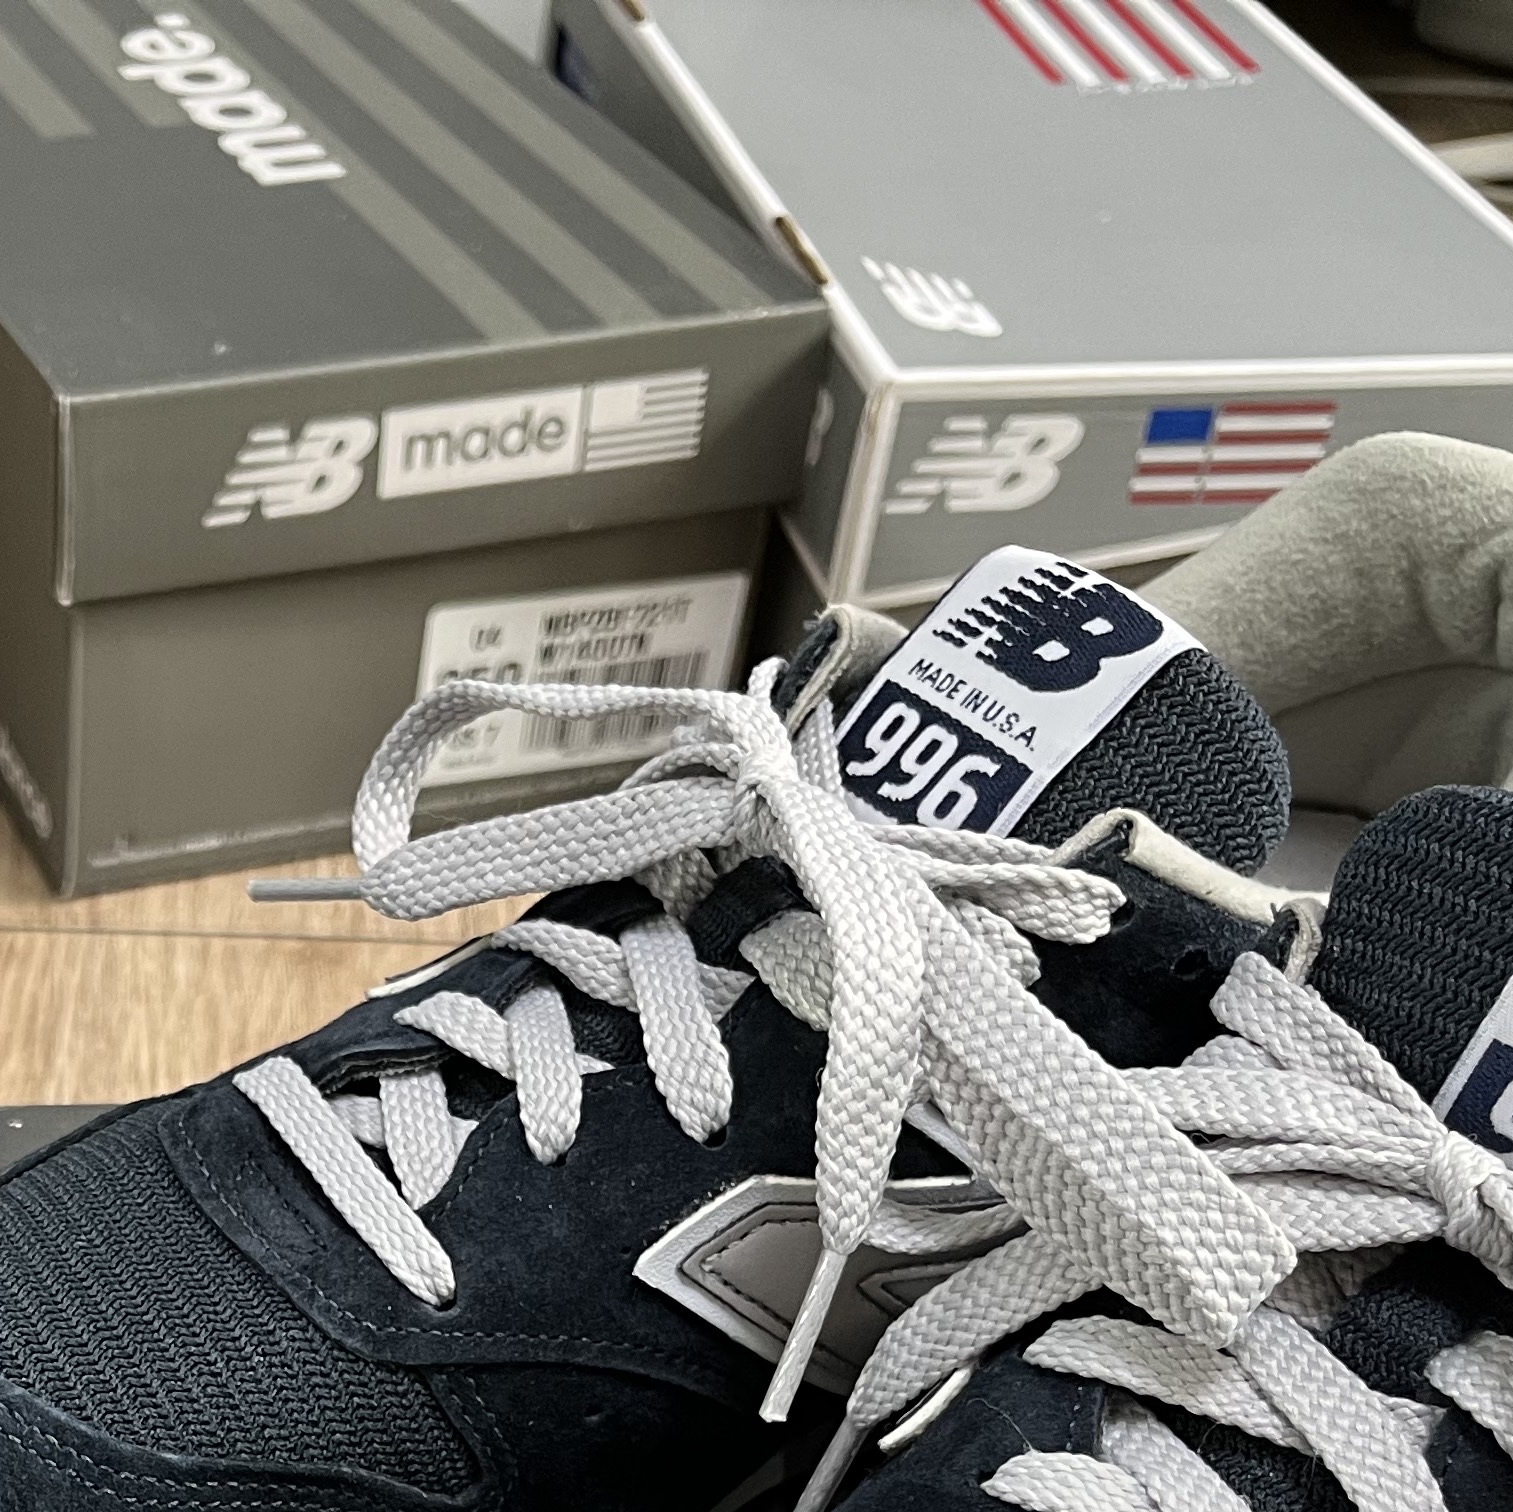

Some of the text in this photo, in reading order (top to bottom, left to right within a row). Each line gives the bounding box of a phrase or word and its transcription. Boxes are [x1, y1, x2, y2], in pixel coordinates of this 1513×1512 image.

[402, 404, 566, 474] made
[908, 658, 967, 700] MADE
[845, 701, 1003, 832] 996
